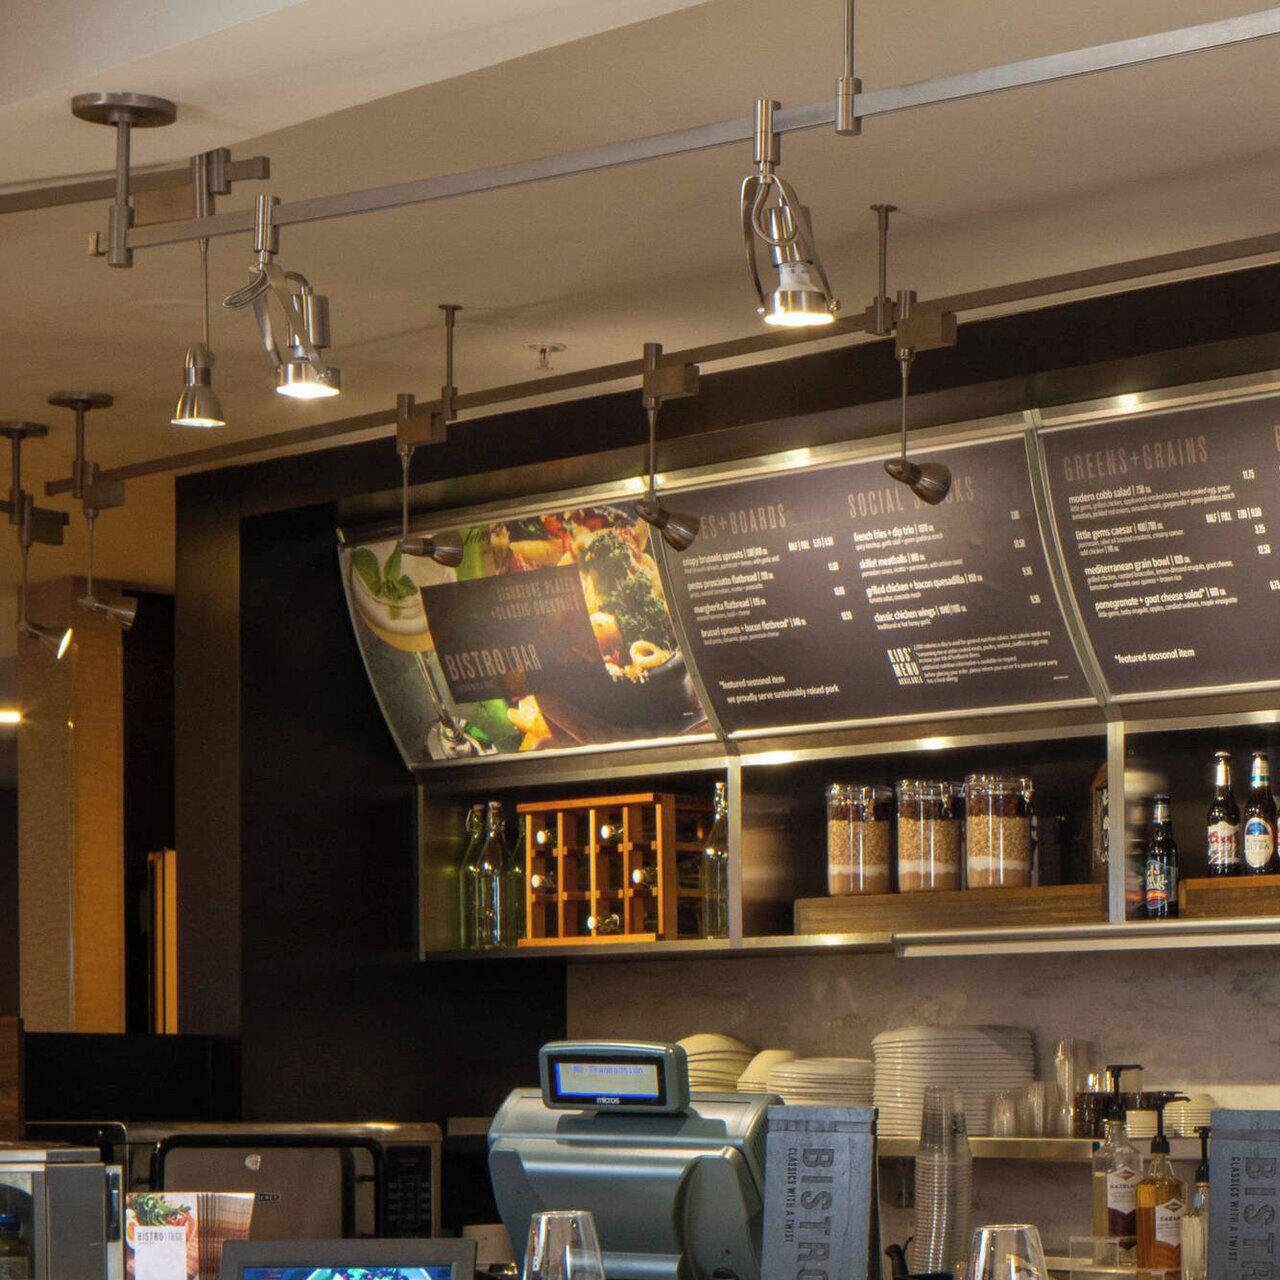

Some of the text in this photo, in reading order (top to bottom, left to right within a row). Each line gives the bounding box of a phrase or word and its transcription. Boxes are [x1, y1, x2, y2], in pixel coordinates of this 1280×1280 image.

[1063, 436, 1208, 482] GREENS+GRAINS
[848, 487, 904, 518] SOCIAL
[1069, 486, 1131, 504] modern cobb salad
[1075, 525, 1134, 541] little gems caesar
[1134, 559, 1152, 572] grain
[1152, 556, 1170, 569] bowl
[446, 643, 544, 681] BISTRO BAR
[1147, 649, 1178, 661] seasonal
[1178, 647, 1196, 658] item
[596, 1096, 620, 1105] micros
[137, 1231, 165, 1242] BISTRO
